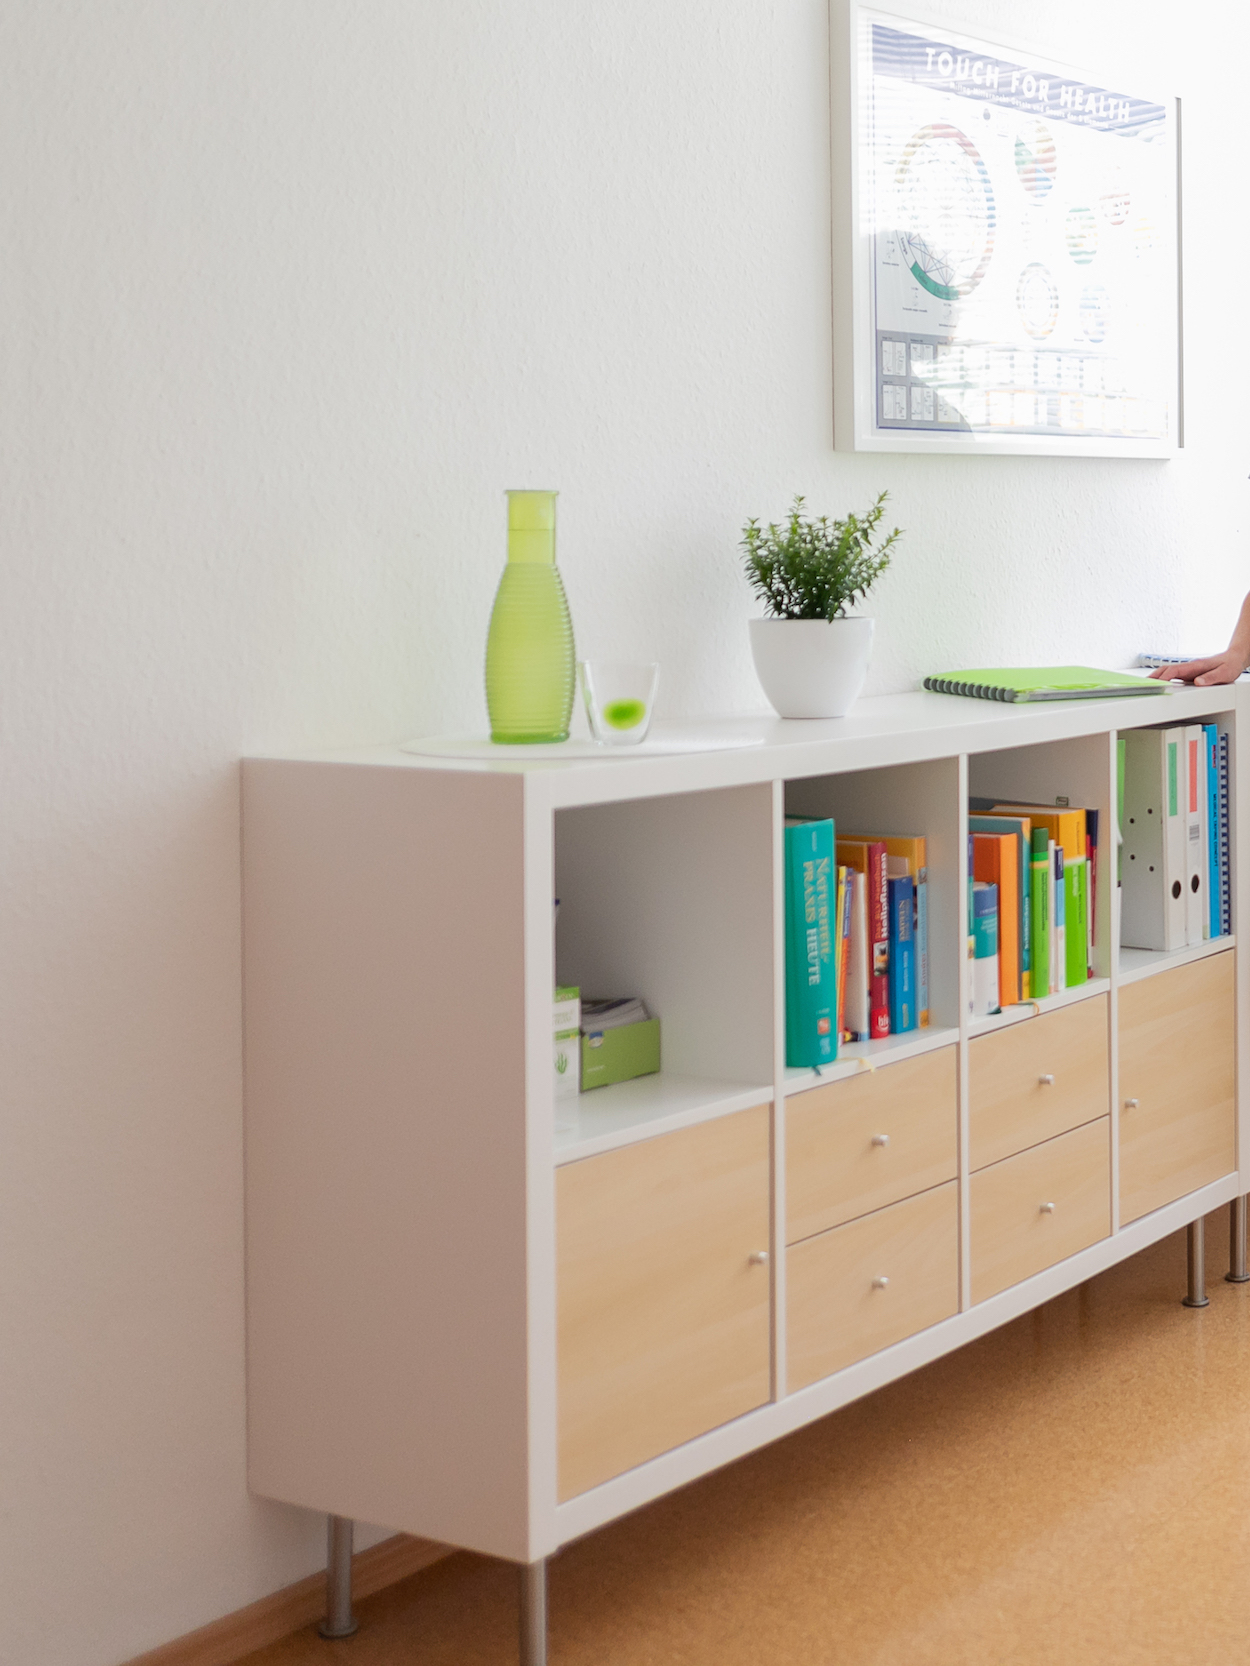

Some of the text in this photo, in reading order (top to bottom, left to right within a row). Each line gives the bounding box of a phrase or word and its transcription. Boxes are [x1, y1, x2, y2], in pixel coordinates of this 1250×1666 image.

[925, 47, 1130, 123] TOUCH FOR HEALTH
[803, 861, 816, 923] PRAXIS
[880, 852, 888, 938] Heilpflanzen
[806, 927, 820, 986] HEUTE
